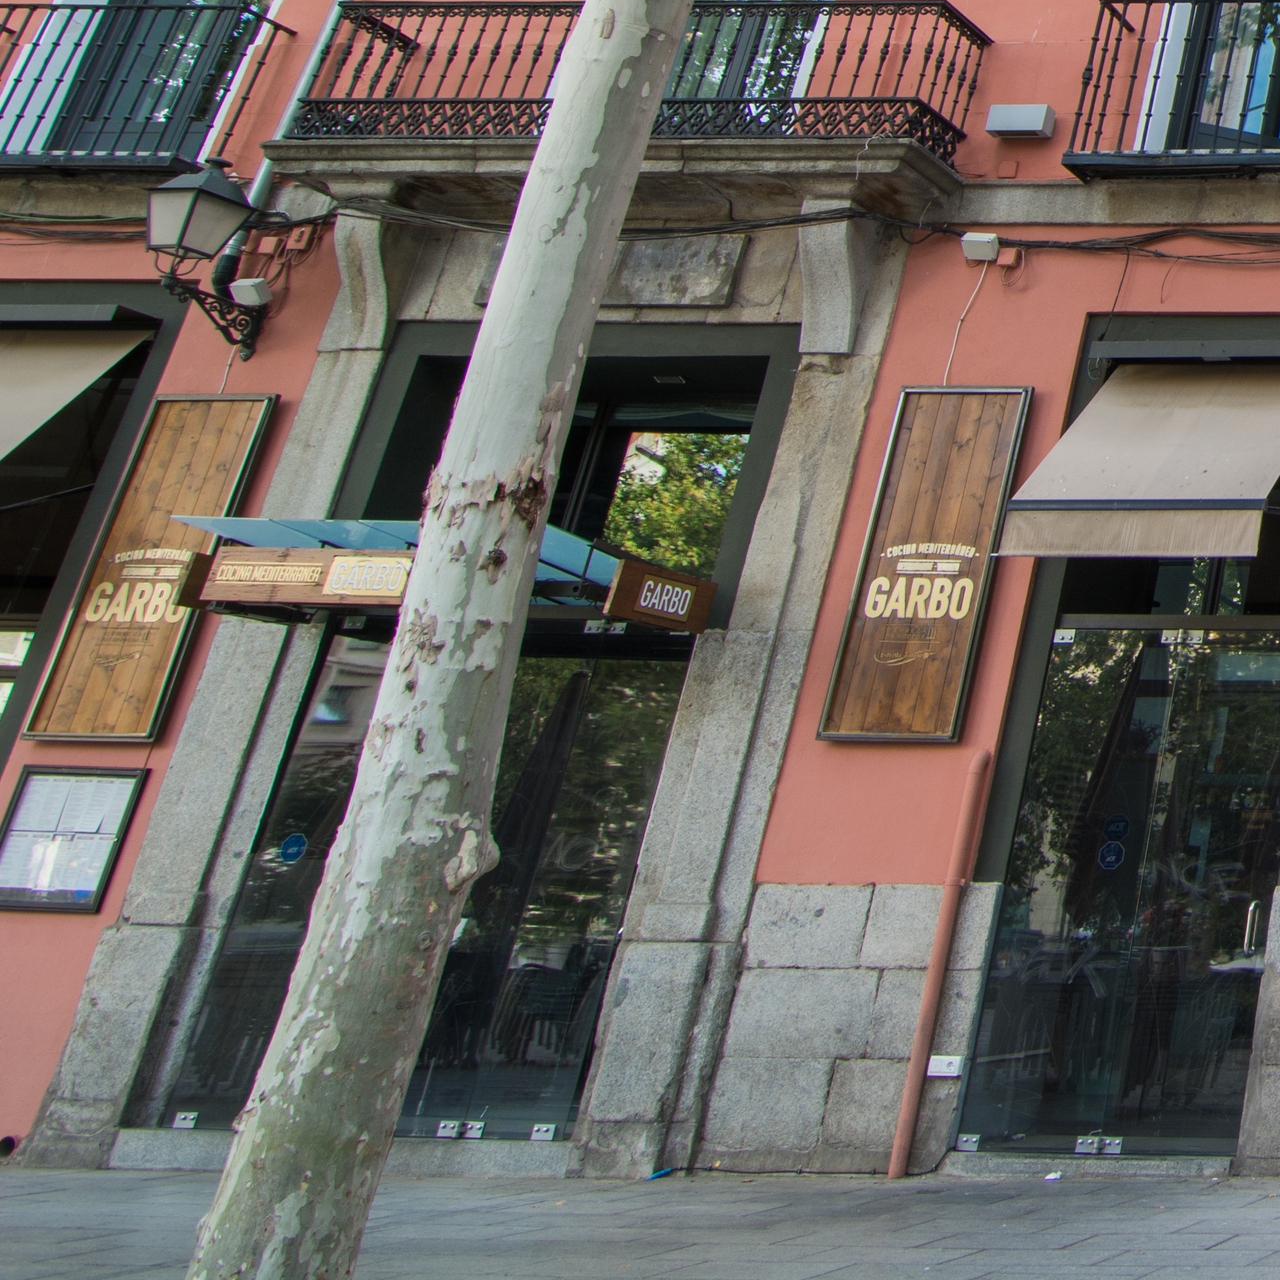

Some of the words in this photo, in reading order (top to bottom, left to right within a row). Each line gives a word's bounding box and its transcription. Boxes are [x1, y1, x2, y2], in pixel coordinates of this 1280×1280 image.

[216, 564, 255, 581] COCINA
[329, 561, 405, 592] GARBO
[640, 580, 692, 616] GARBO
[865, 576, 975, 620] GARBO
